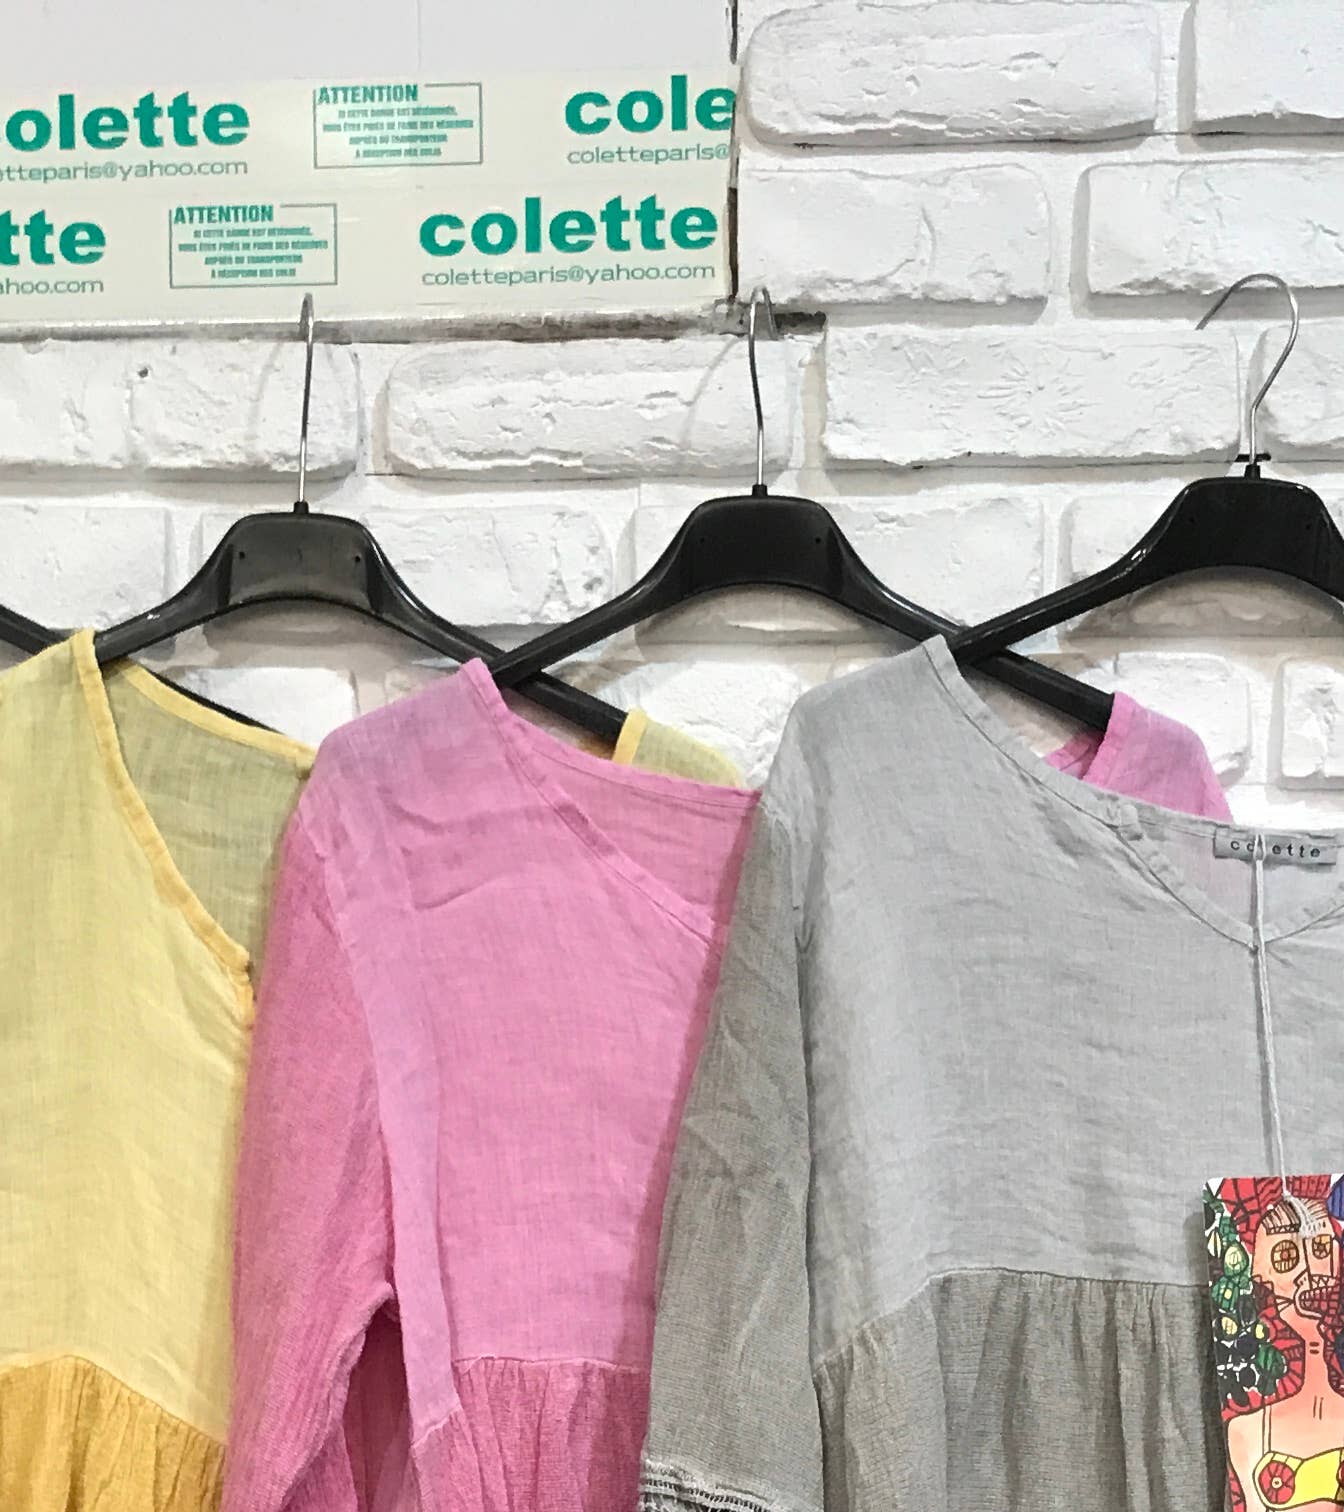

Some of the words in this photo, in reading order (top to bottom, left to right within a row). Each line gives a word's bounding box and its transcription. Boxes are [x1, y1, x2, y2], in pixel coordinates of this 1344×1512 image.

[318, 84, 418, 105] ATTENTION
[174, 204, 273, 224] ATTENTION
[420, 195, 718, 256] colette
[422, 264, 716, 286] coletteparis@yahoo.com
